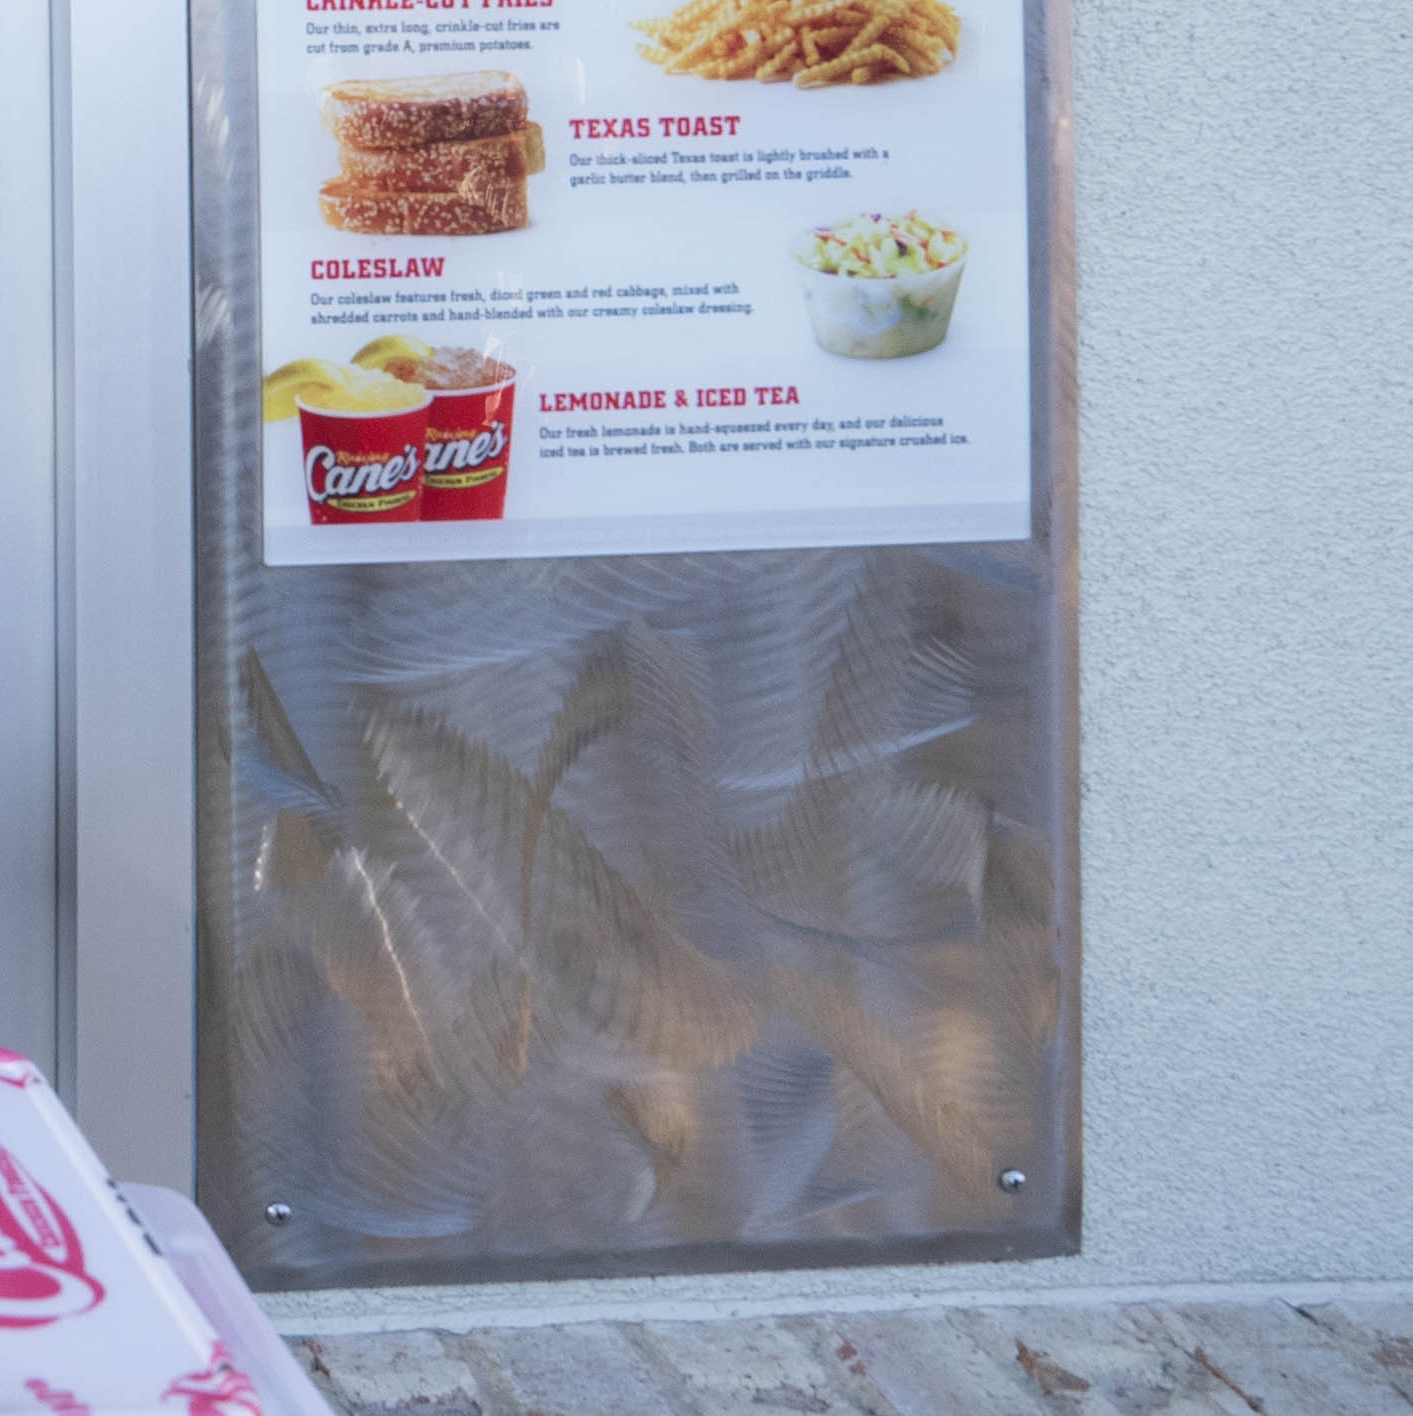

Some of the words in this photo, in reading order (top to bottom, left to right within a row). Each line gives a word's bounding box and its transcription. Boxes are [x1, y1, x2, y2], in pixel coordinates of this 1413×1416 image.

[306, 23, 328, 35] Our
[365, 23, 397, 34] extra
[507, 19, 536, 31] fries
[539, 21, 560, 31] are
[306, 42, 325, 54] cut
[329, 42, 359, 53] from
[363, 41, 399, 55] grade
[419, 41, 475, 53] premium
[569, 118, 651, 139] TEXAS
[659, 116, 741, 137] TOAST
[311, 257, 445, 280] COLESLAW
[310, 292, 333, 305] Our
[337, 291, 391, 305] coleslaw
[395, 290, 446, 303] features
[565, 287, 588, 299] and
[592, 286, 612, 298] red
[713, 282, 739, 294] with
[311, 311, 369, 324] shredded
[372, 311, 418, 323] carrots
[422, 310, 445, 322] and
[537, 306, 564, 318] with
[540, 390, 666, 412] LEMONADE
[674, 390, 689, 408] &
[696, 388, 747, 408] ICED
[754, 386, 800, 405] TEA
[306, 444, 421, 502] Cane's
